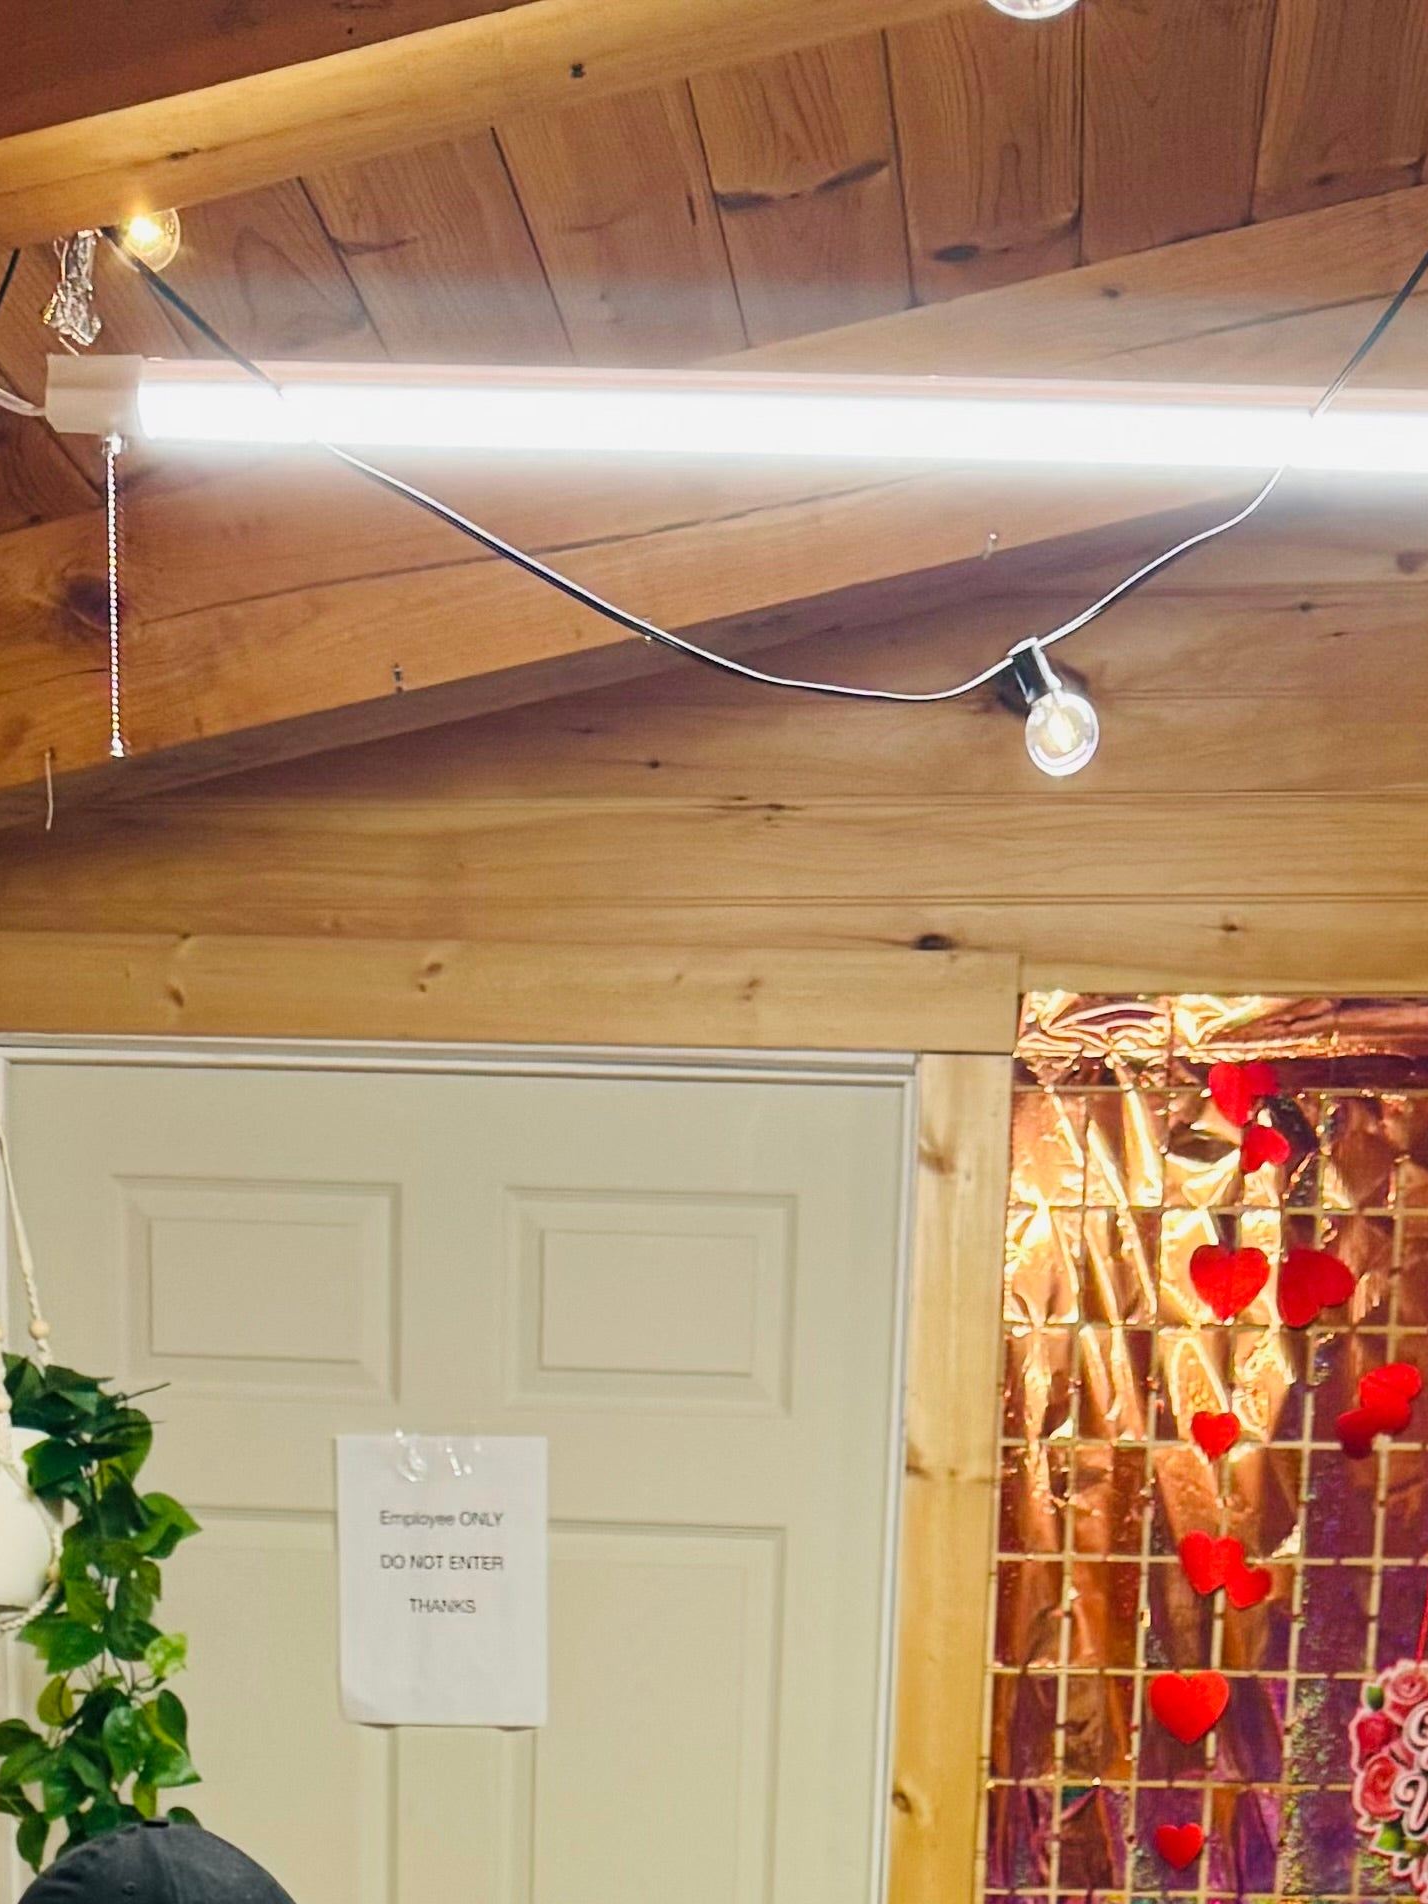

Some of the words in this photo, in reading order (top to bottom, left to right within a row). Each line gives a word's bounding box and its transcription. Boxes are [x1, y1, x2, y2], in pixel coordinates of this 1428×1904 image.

[380, 1511, 455, 1528] Employee
[459, 1512, 504, 1526] ONLY
[381, 1555, 405, 1570] DO
[410, 1556, 443, 1570] NOT
[449, 1556, 504, 1571] ENTER
[410, 1599, 476, 1614] THANKS
